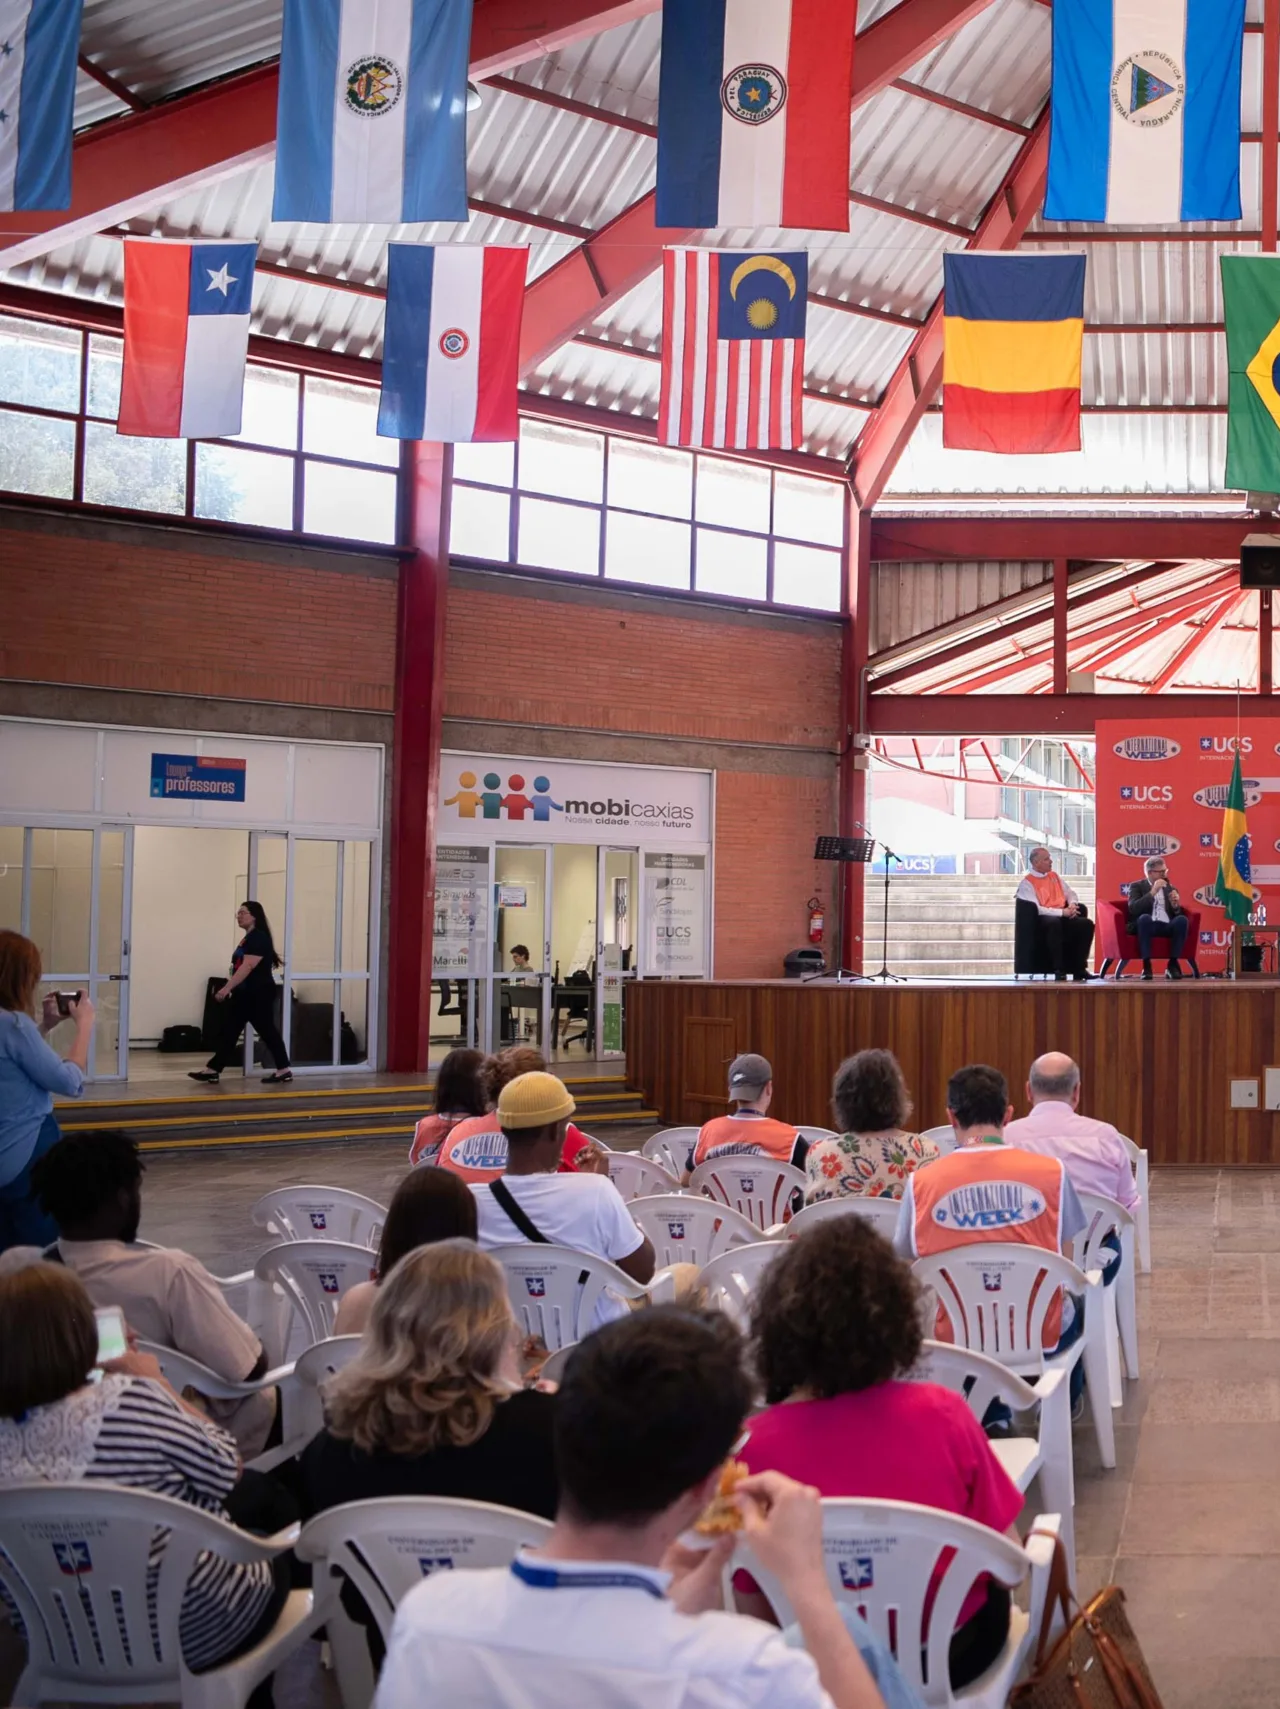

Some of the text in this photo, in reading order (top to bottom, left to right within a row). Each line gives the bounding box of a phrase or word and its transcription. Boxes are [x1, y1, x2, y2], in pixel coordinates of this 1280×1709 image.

[386, 60, 394, 69] EL
[393, 67, 402, 96] SALVADOR
[728, 86, 736, 100] DEL
[733, 70, 770, 82] PARAGUAY
[1177, 83, 1184, 95] DE
[344, 96, 366, 117] CENTRAL
[1110, 88, 1130, 121] CENTRAL
[1140, 97, 1183, 127] NICARAGUA
[1124, 738, 1168, 751] INTERNATIONAL
[1213, 736, 1253, 753] UCS
[1125, 750, 1168, 759] WEEK
[165, 776, 236, 795] professores
[1134, 786, 1174, 802] UCS
[564, 799, 694, 821] mobicaxias
[564, 816, 593, 824] Nossa
[634, 820, 660, 828] nosso
[662, 820, 692, 829] futuro
[1124, 836, 1167, 849] INTERNATIONAL
[1125, 848, 1167, 856] WEEK
[904, 858, 930, 871] UCS
[671, 877, 688, 886] CDL
[665, 926, 691, 938] UCS
[433, 955, 467, 965] Marelli
[462, 1155, 506, 1167] WEE
[949, 1184, 1024, 1216] INTERNATIONAL
[951, 1207, 1025, 1227] WEEK
